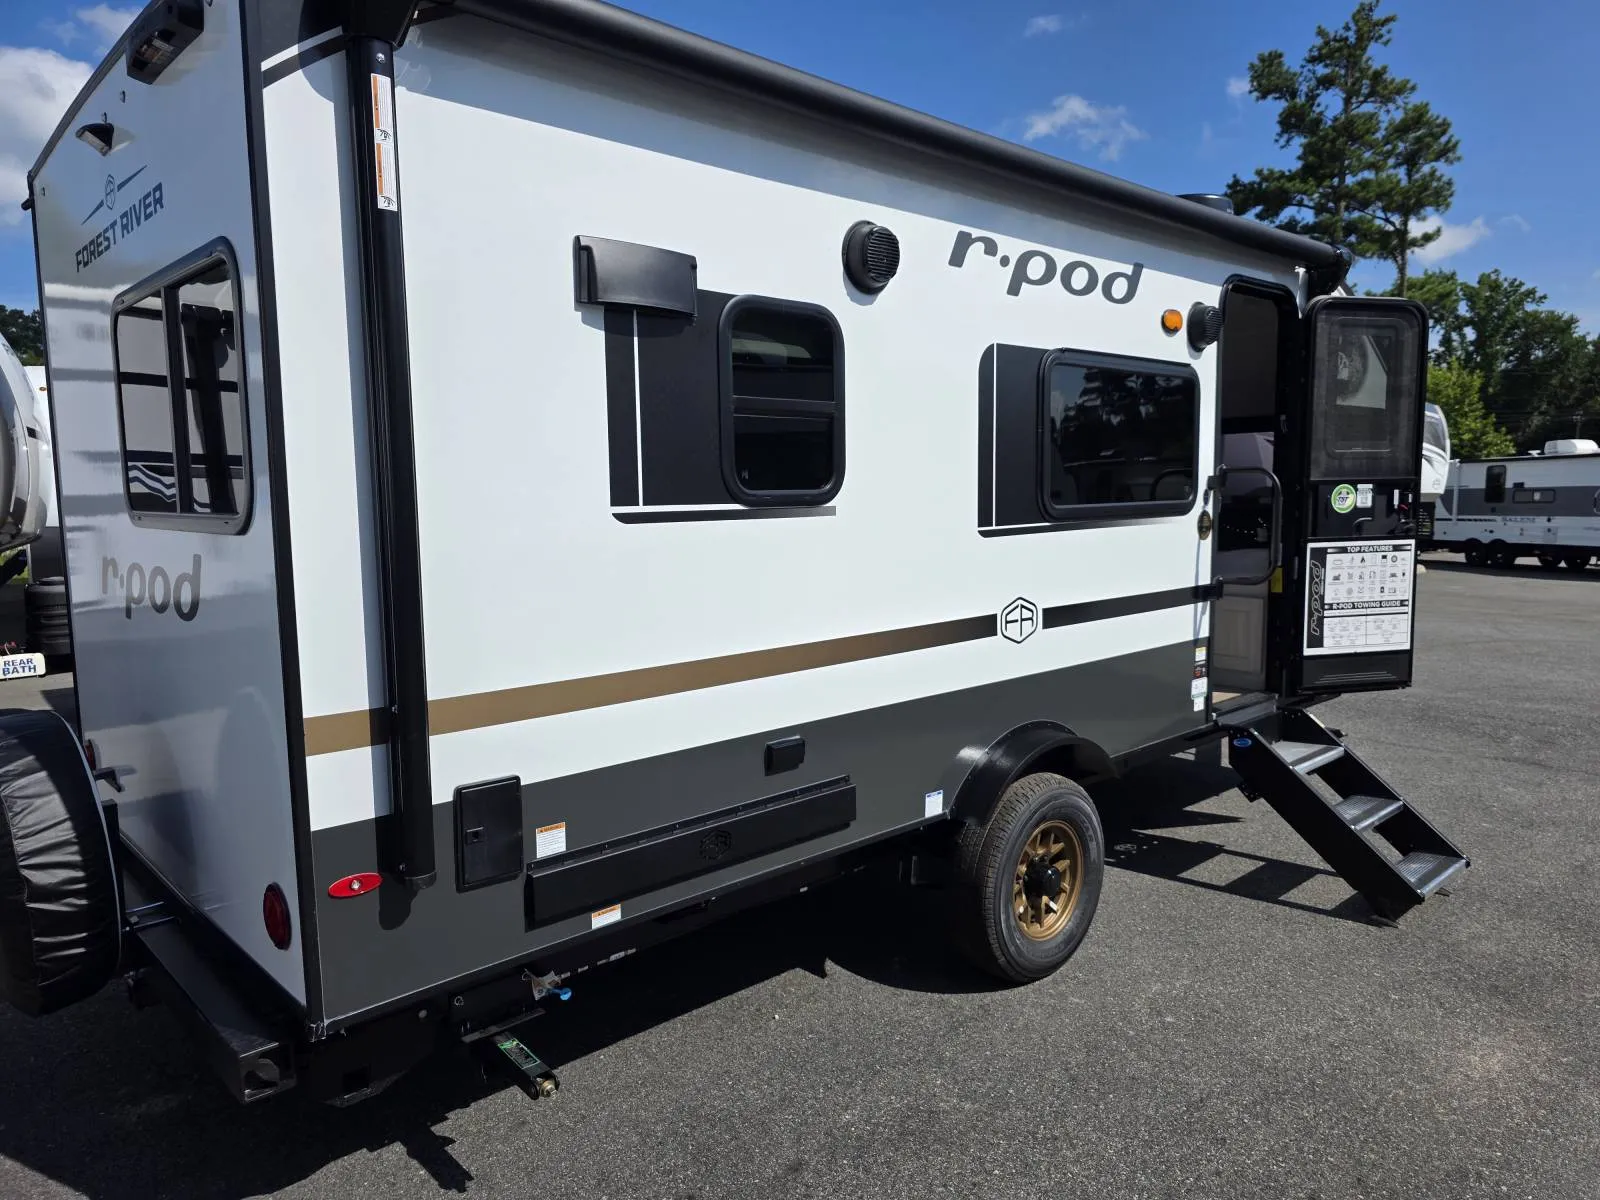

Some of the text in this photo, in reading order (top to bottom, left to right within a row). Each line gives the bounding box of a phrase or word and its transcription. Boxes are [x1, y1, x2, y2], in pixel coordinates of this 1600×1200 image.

[75, 182, 164, 273] FOREST RIVER
[1360, 545, 1393, 553] FEATURES
[1332, 600, 1401, 610] R-POD TOWING GUIDE
[3, 658, 34, 667] REAR
[2, 665, 37, 676] BATH
